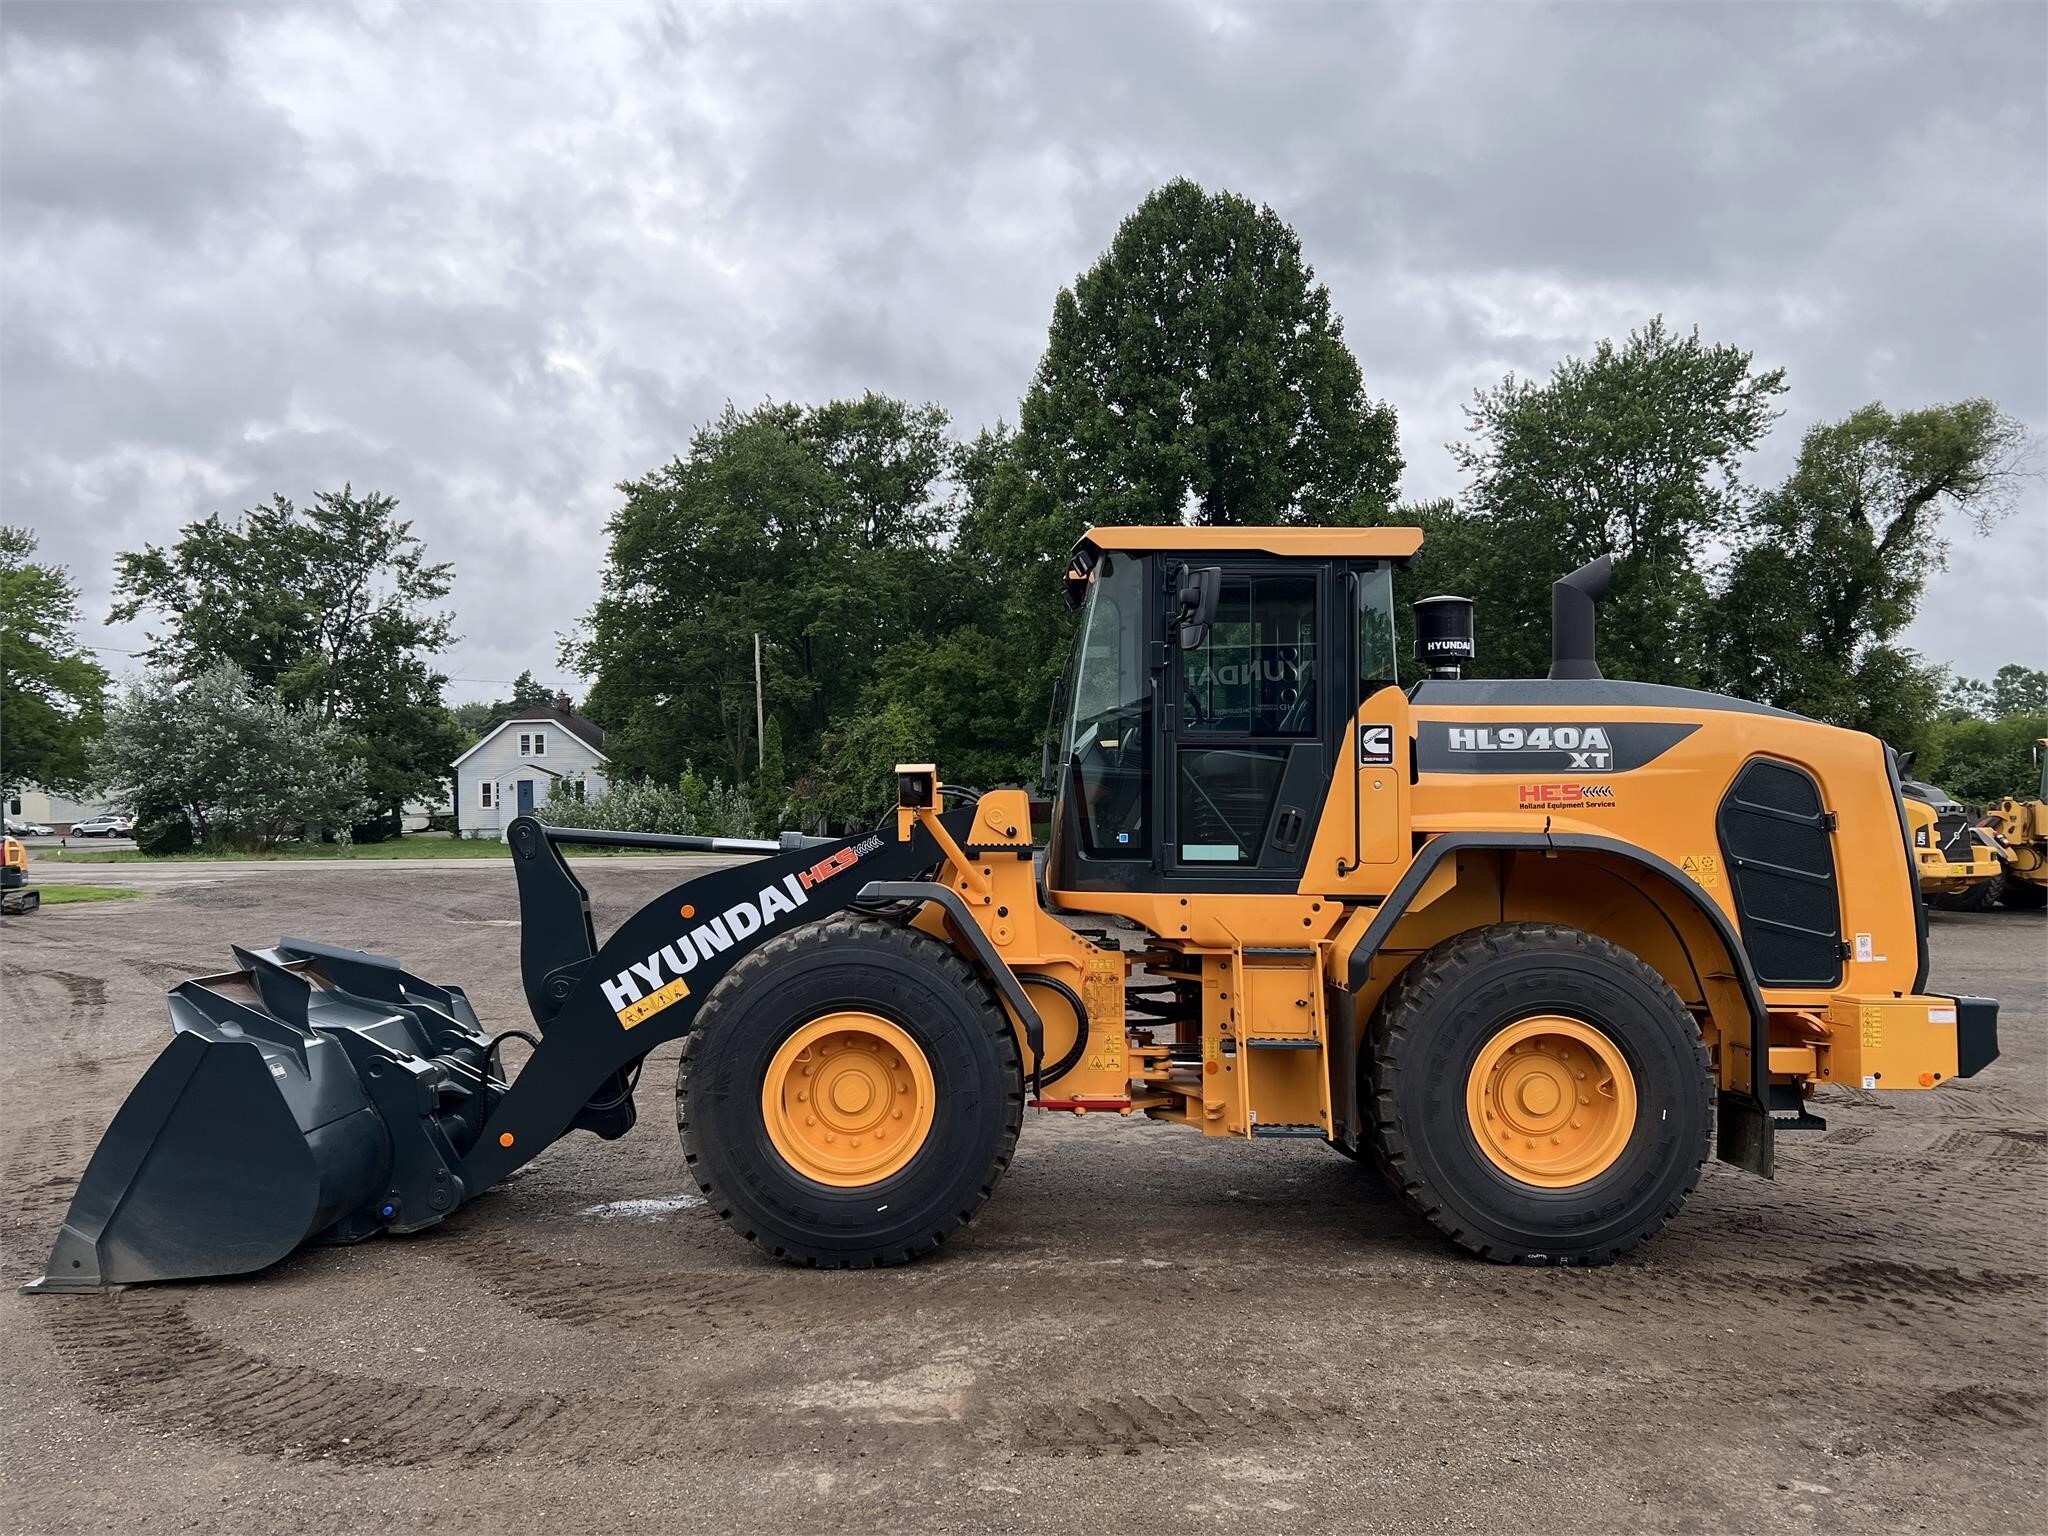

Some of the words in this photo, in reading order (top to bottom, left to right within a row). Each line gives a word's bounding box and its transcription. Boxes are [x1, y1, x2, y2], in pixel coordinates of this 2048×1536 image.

[1427, 641, 1471, 651] HYUNDAI
[1449, 727, 1609, 751] HL940A
[1568, 752, 1610, 768] XT
[1519, 784, 1582, 802] HES
[1547, 802, 1584, 810] Equipment
[799, 847, 859, 889] HES
[600, 873, 809, 1013] HYUNDAI
